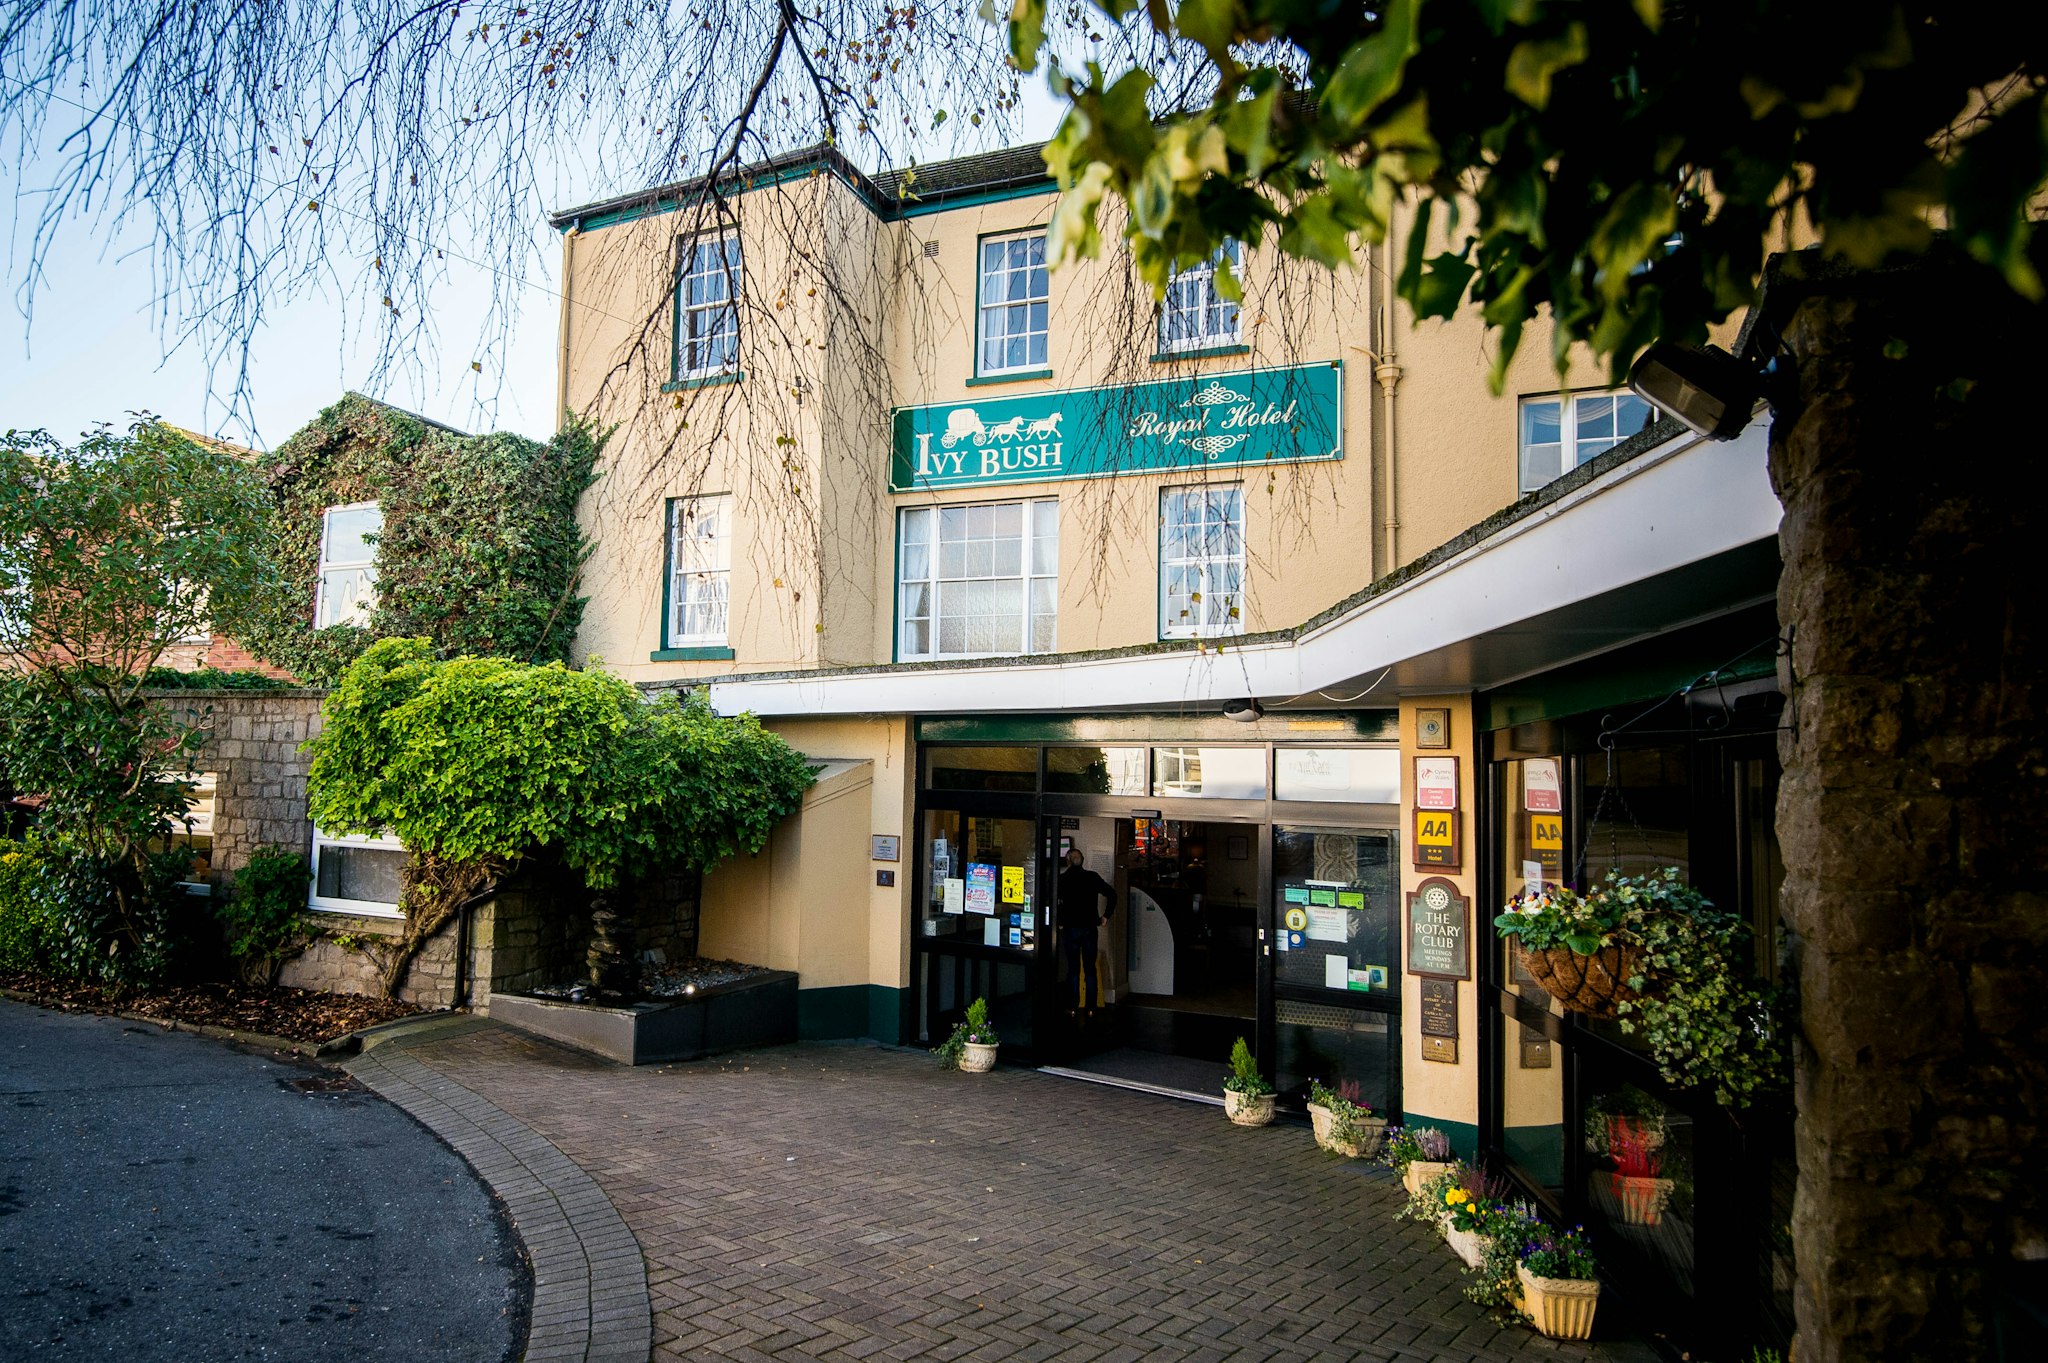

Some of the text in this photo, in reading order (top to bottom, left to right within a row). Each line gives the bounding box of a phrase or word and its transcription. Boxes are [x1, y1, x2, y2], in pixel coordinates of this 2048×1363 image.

[1129, 399, 1298, 445] Royal Hotel
[915, 432, 1064, 478] IVY BUSH
[1421, 820, 1447, 837] AA
[1425, 911, 1450, 925] THE
[1415, 922, 1461, 937] ROTARY
[1421, 935, 1454, 949] CLUB
[1423, 948, 1453, 956] MEETINGS
[1424, 955, 1451, 963] MONDAYS
